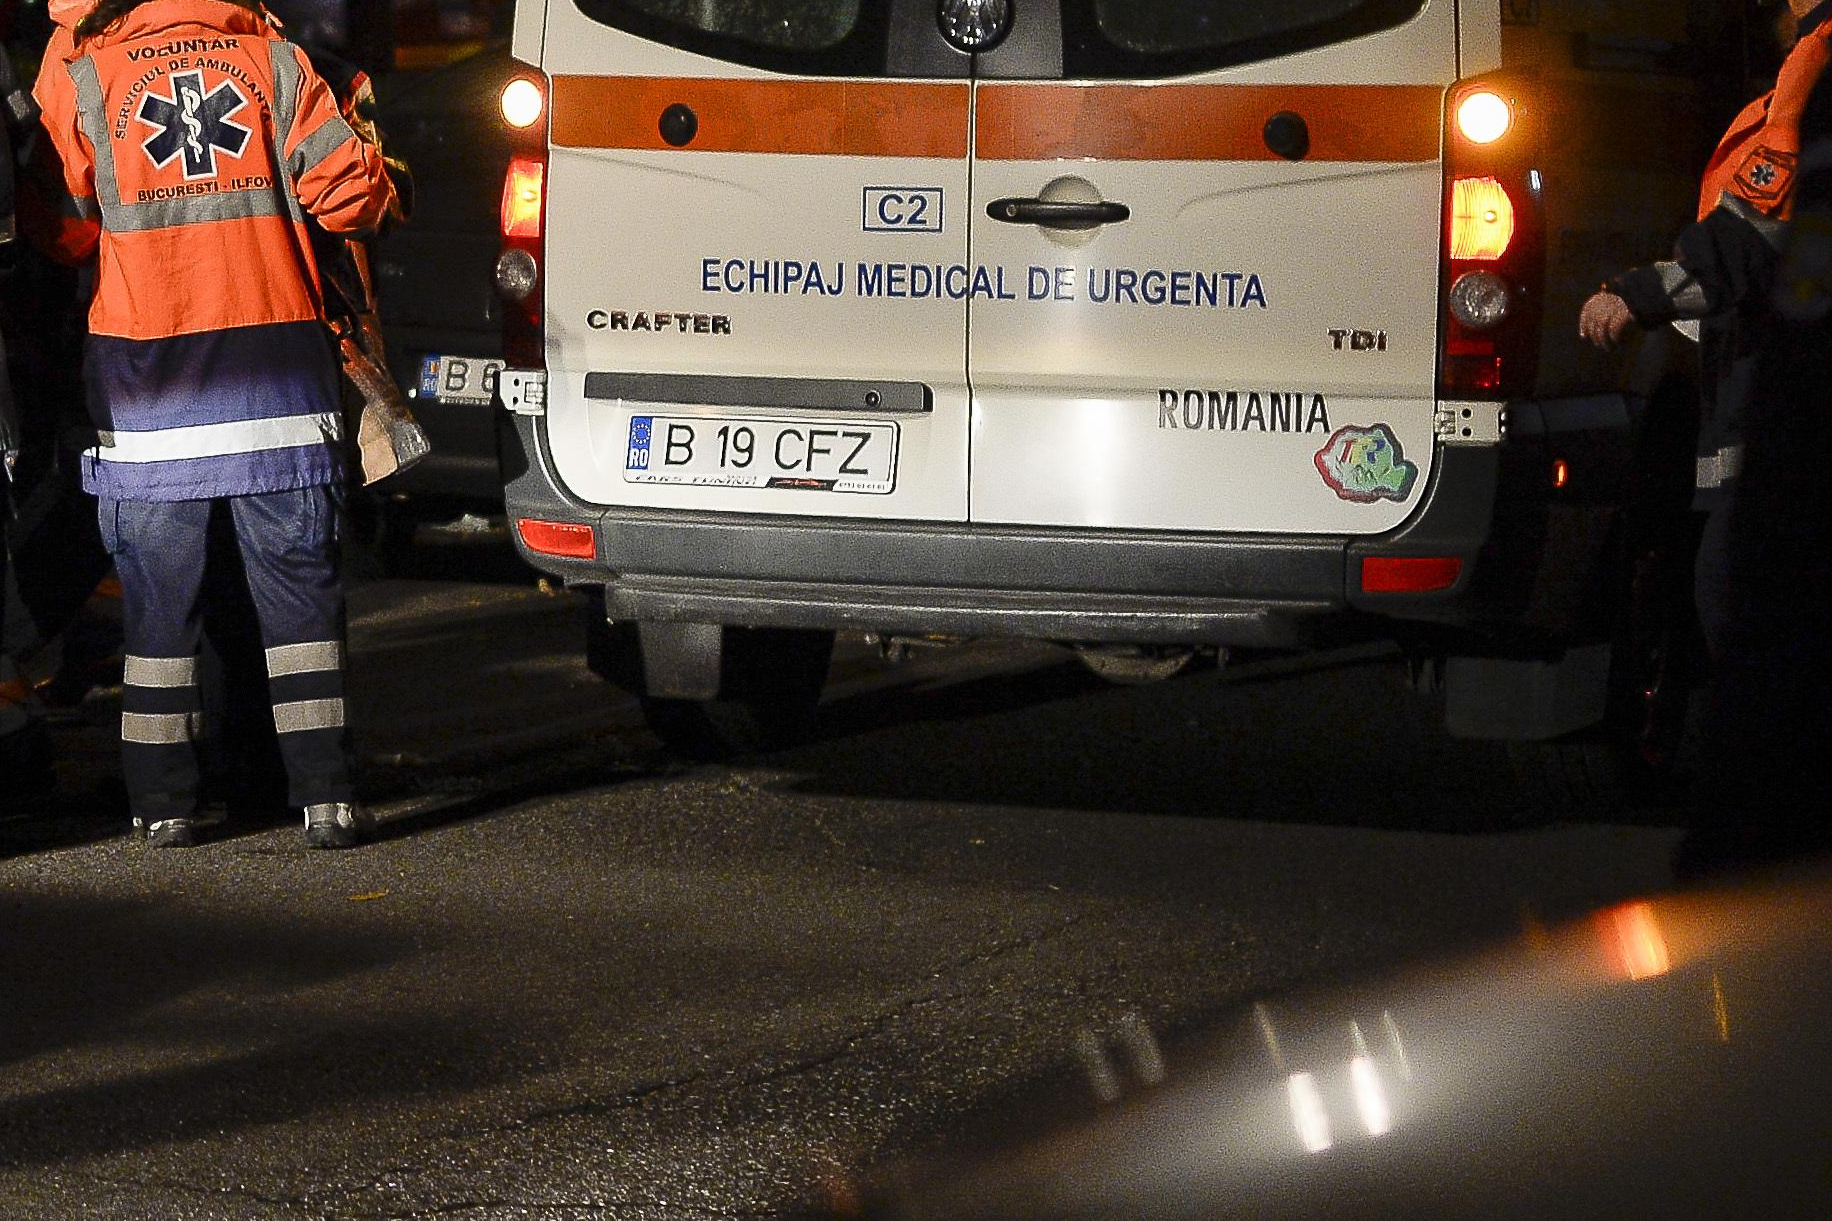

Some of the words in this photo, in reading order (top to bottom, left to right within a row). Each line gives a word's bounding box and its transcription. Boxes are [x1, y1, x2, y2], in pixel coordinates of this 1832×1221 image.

[115, 65, 165, 140] SERVICIUL
[168, 57, 190, 71] DE
[137, 182, 220, 202] BUCURESTI
[877, 193, 929, 226] C2
[701, 258, 845, 298] ECHIPAJ
[857, 261, 1016, 301] MEDICAL
[1028, 266, 1076, 302] DE
[1088, 267, 1268, 309] URGENTA
[586, 309, 731, 335] CRAFTER
[1327, 329, 1388, 352] TDI
[1157, 389, 1331, 434] ROMANIA
[628, 448, 649, 468] RO
[664, 424, 696, 466] B
[717, 425, 756, 468] 19
[774, 428, 872, 475] CFZ
